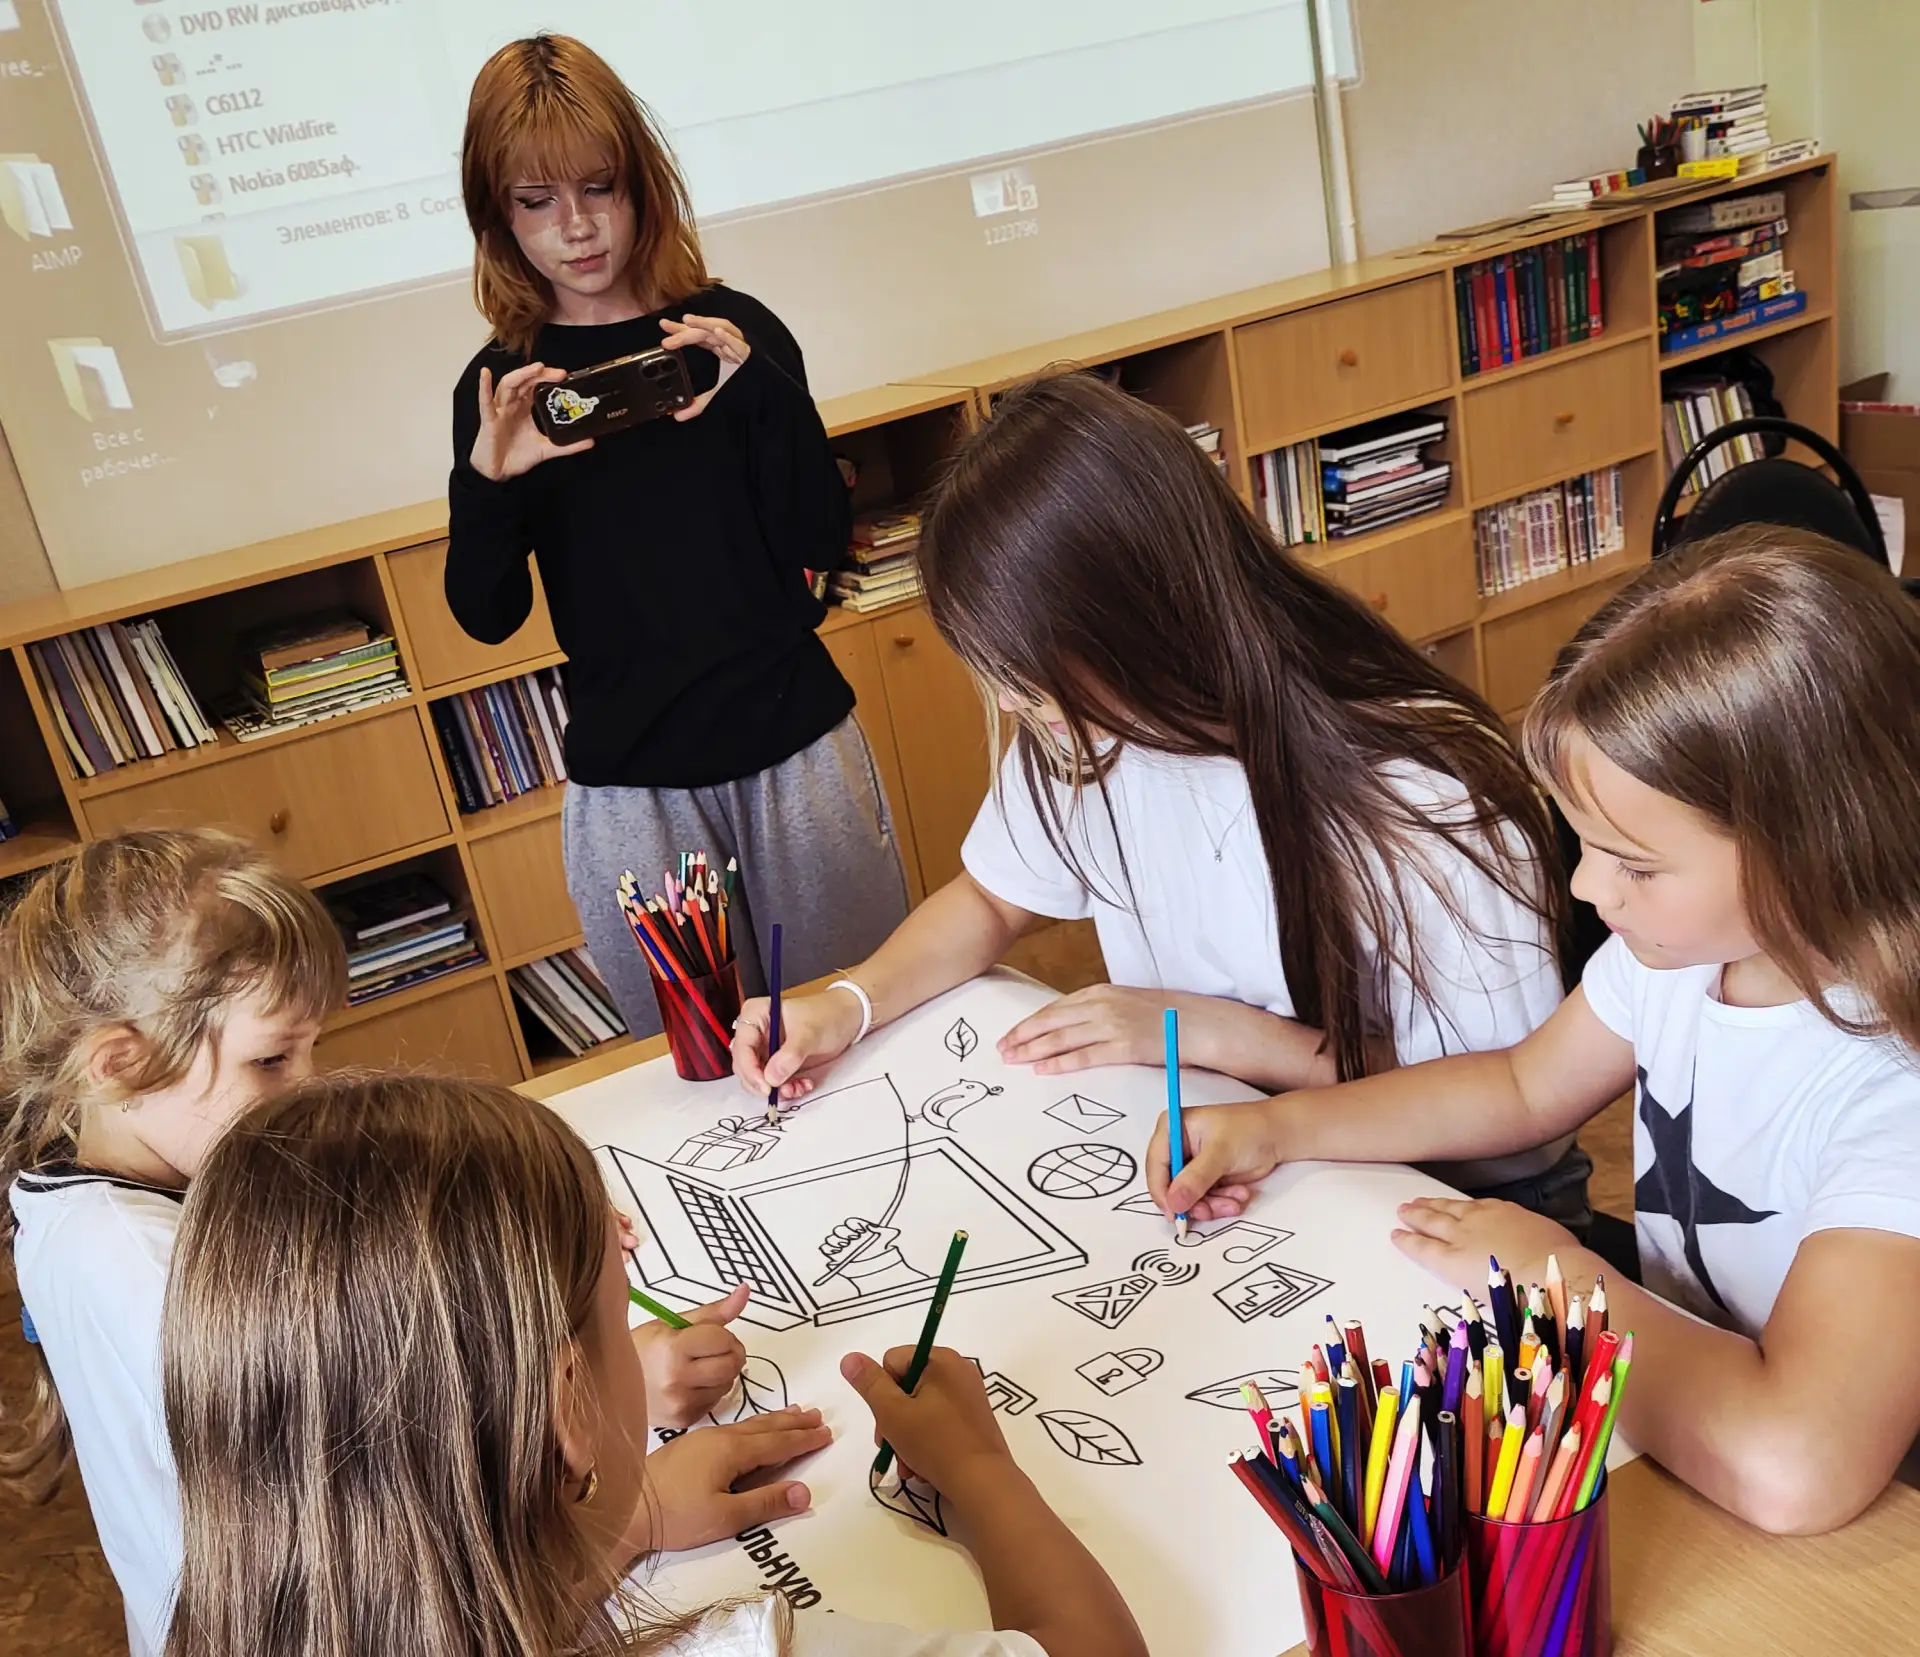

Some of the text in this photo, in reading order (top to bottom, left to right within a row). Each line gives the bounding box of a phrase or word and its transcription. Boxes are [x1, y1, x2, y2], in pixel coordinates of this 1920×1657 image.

[179, 10, 224, 36] DVD
[226, 4, 260, 27] RW
[205, 88, 265, 116] C6112
[216, 118, 338, 156] HTC Wildfire
[228, 168, 286, 195] Nokia
[276, 207, 393, 244] Элементов:
[395, 202, 411, 221] 8
[31, 245, 84, 272] AIMP
[92, 430, 131, 451] Все
